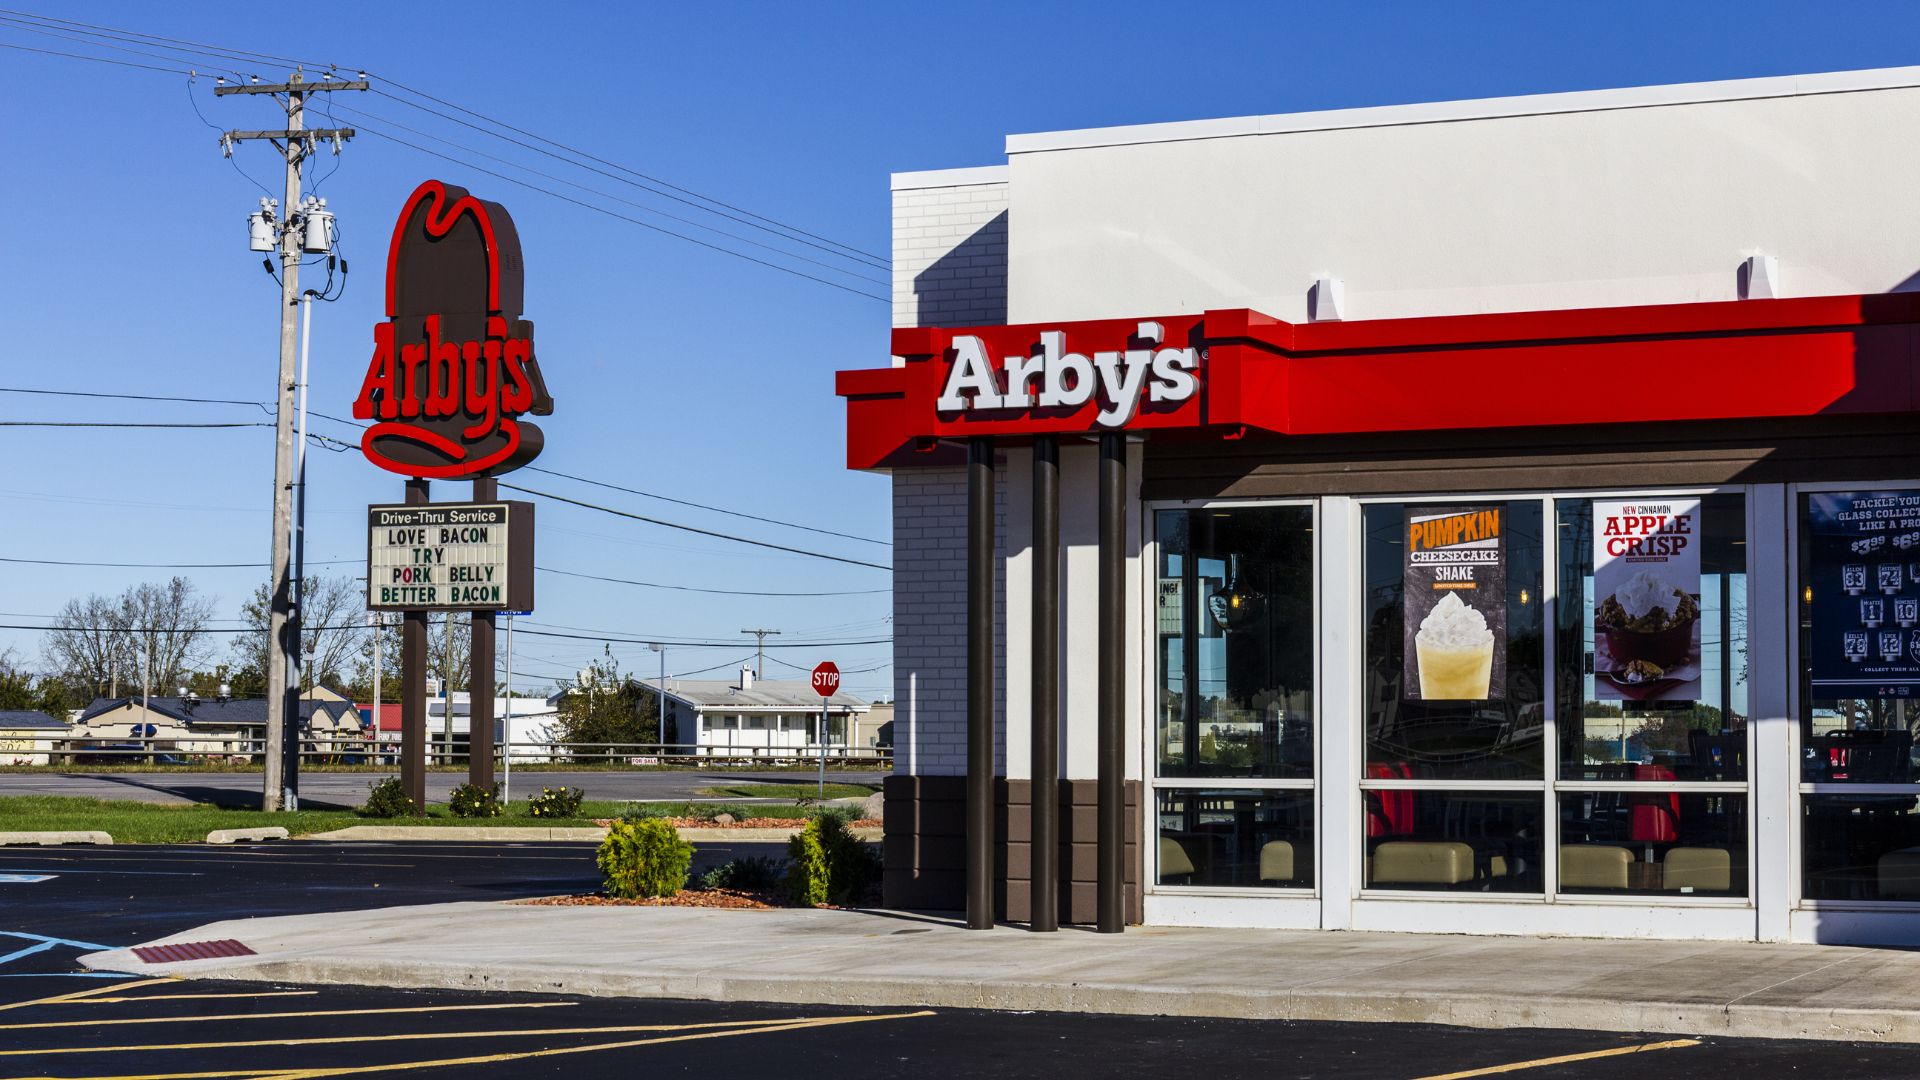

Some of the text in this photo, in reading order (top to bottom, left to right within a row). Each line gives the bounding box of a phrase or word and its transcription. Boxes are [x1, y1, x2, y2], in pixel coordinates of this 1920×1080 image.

[353, 314, 533, 439] Arby's
[937, 321, 1199, 427] Arby's
[1622, 504, 1671, 515] NEW CINNAMON
[1853, 498, 1895, 509] TACKLE
[380, 509, 497, 524] Drive-Thru Service
[1838, 510, 1872, 521] GLASS
[1409, 509, 1499, 551] PUMPKIN
[1603, 515, 1691, 536] APPLE
[1859, 520, 1886, 531] LIKE
[1888, 520, 1897, 529] A
[388, 527, 488, 545] LOVE BACON
[1606, 535, 1688, 557] CRISP
[413, 548, 444, 563] TRY
[1410, 550, 1499, 562] CHEESECAKE
[393, 566, 494, 583] PORK BELLY
[1435, 566, 1474, 581] SHAKE
[1881, 571, 1899, 585] 74
[382, 586, 500, 603] BETTER BACON
[1869, 605, 1875, 619] 1
[1898, 604, 1914, 619] 10
[1882, 638, 1899, 653] 12
[813, 671, 839, 687] STOP
